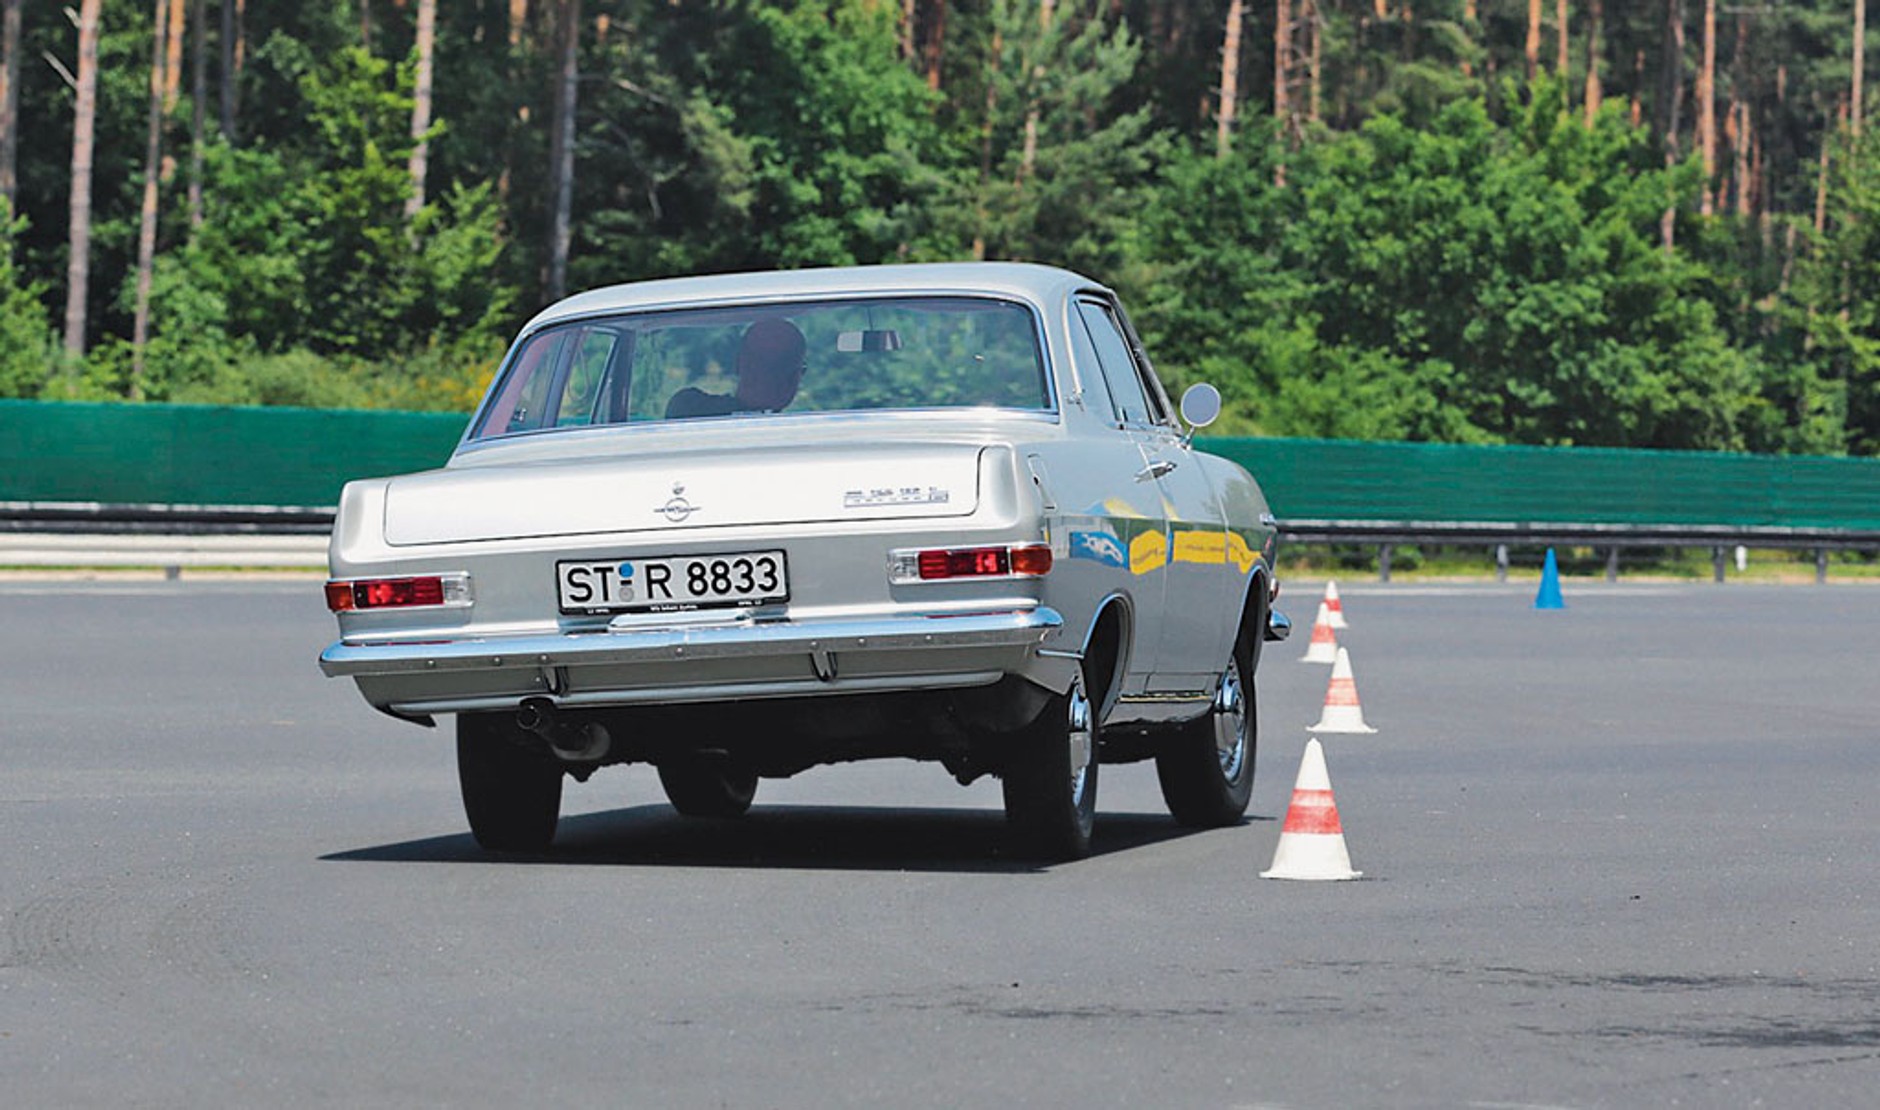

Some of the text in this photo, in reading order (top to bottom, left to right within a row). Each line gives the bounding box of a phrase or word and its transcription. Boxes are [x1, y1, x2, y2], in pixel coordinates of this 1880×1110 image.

[567, 566, 614, 602] ST
[645, 564, 672, 599] R
[687, 557, 778, 596] 8833
